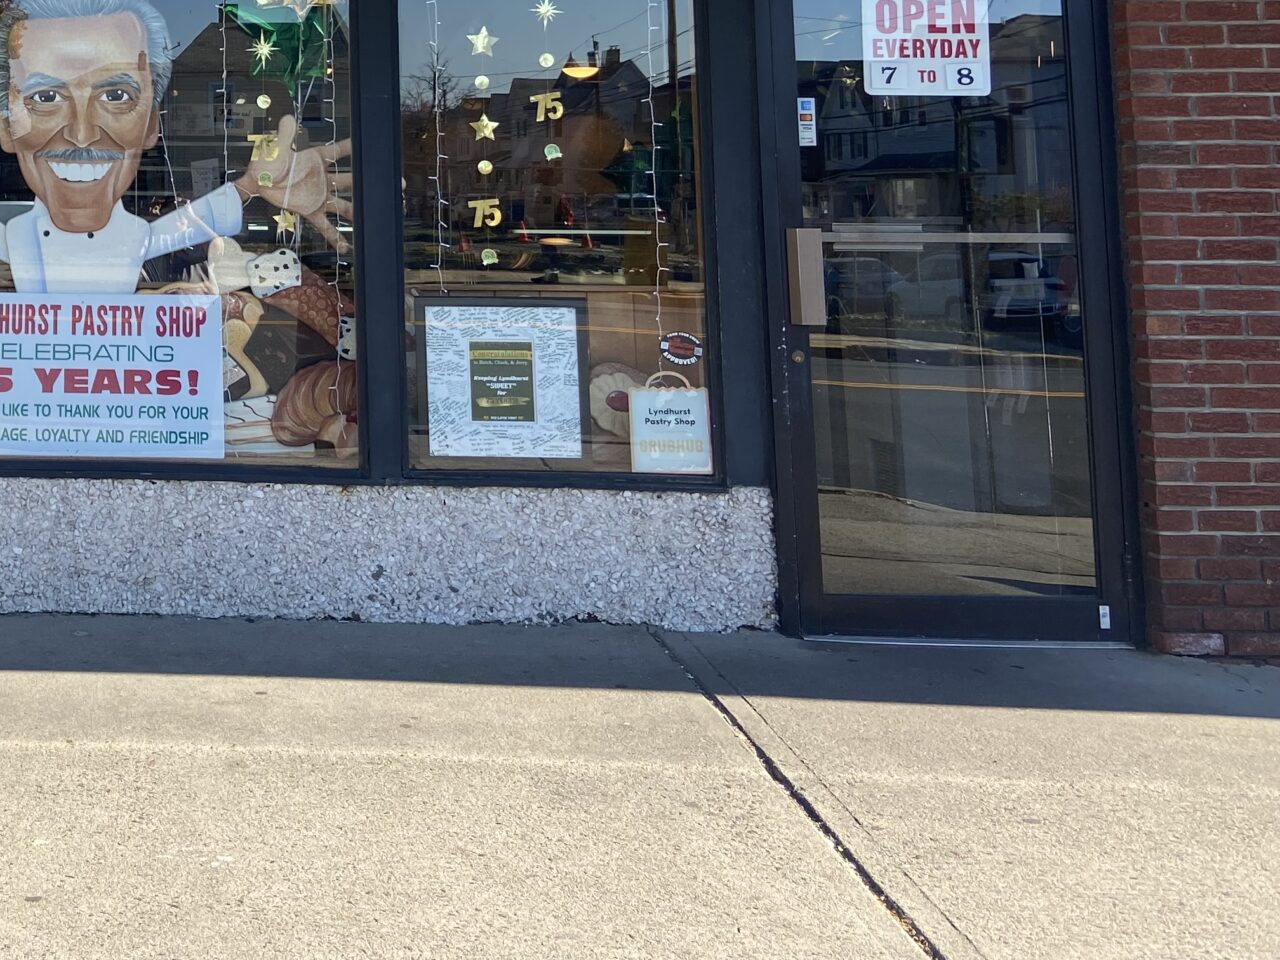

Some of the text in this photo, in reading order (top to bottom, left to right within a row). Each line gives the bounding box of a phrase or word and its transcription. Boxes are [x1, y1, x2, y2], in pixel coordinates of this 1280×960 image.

[875, 0, 975, 34] OPEN
[872, 39, 980, 58] EVERYDAY
[881, 67, 974, 85] 7 TO 8
[529, 91, 564, 122] 75
[468, 199, 502, 228] 75
[72, 304, 145, 336] PASTRY
[155, 305, 207, 337] SHOP
[34, 368, 199, 395] YEARS!
[2, 404, 29, 417] LIKE
[34, 404, 52, 417] TO
[57, 405, 100, 418] THANK
[107, 406, 133, 418] YOU
[139, 406, 166, 419] FOR
[172, 407, 208, 420] YOUR
[648, 408, 691, 416] Lyndhurst
[645, 418, 696, 426] Pastry Shop
[36, 429, 90, 442] LOYALTY
[96, 430, 124, 443] AND
[129, 431, 209, 445] FRIENDSHIP
